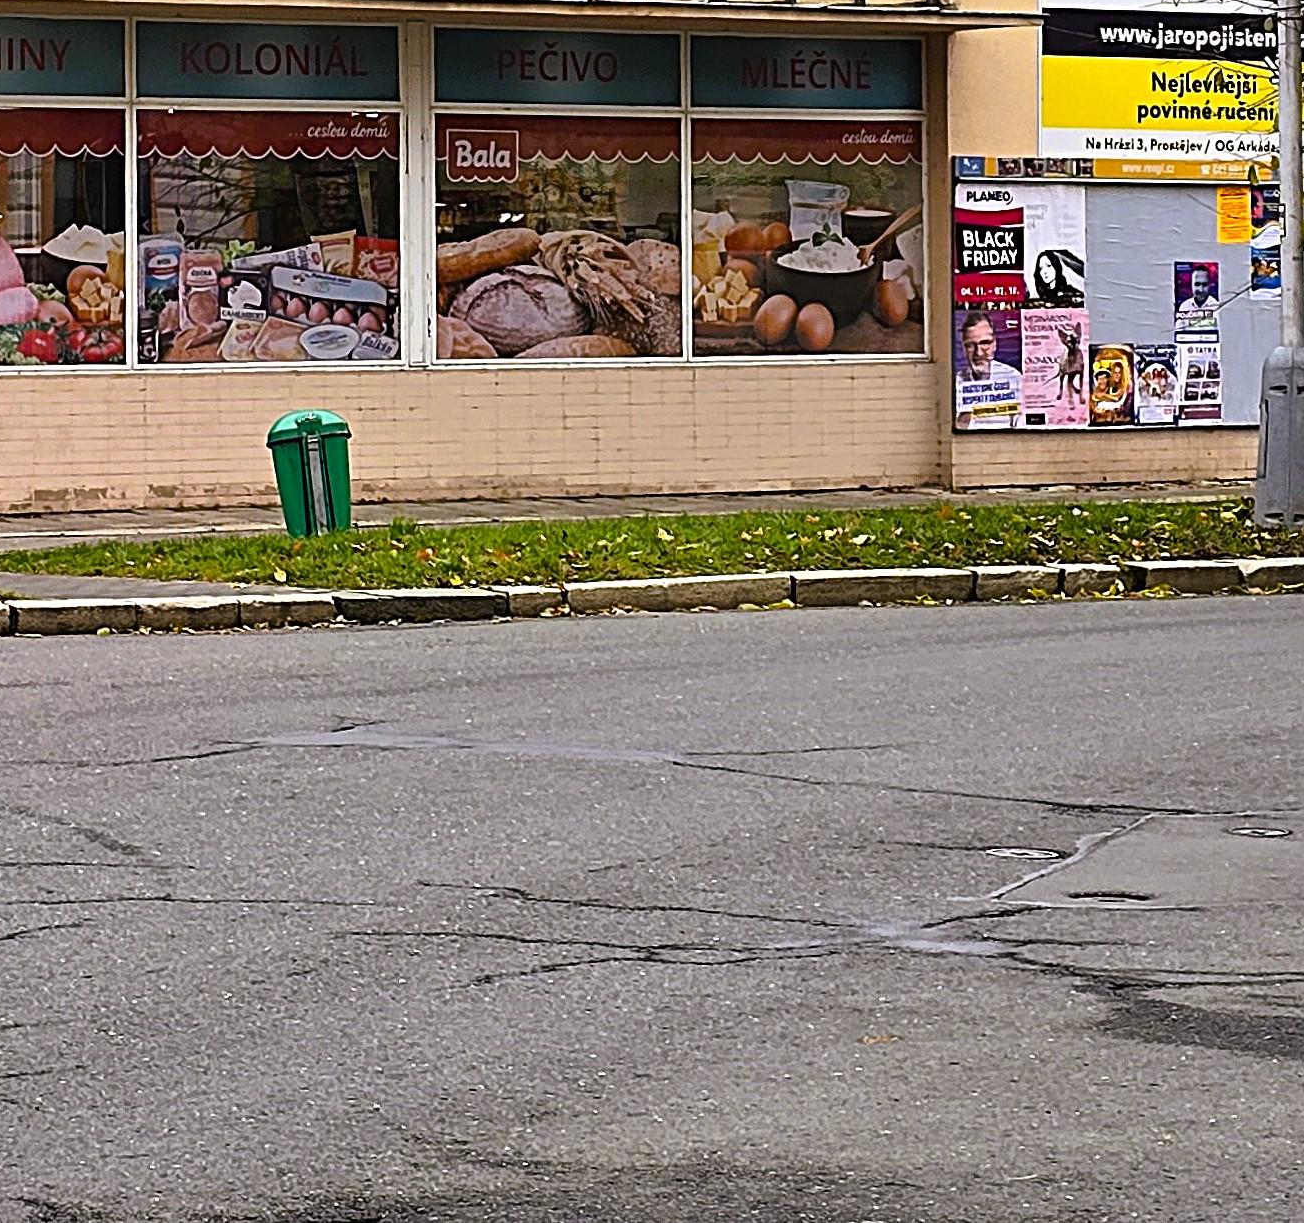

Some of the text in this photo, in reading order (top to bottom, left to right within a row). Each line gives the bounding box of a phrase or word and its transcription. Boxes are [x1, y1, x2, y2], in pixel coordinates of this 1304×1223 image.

[180, 36, 369, 77] KOLONIÁL
[497, 41, 618, 83] PEČIVO
[740, 49, 872, 91] MLÉČNÉ
[1137, 101, 1213, 124] povinné
[307, 119, 349, 138] cestou
[350, 116, 391, 138] domů
[841, 128, 878, 145] cestou
[880, 128, 914, 145] domů
[455, 139, 512, 170] Bala
[1086, 138, 1101, 150] Na
[1137, 139, 1148, 153] 3,
[1214, 140, 1235, 152] OG
[966, 191, 1013, 204] PLANEO
[962, 230, 1015, 248] BLACK
[963, 249, 1018, 268] FRIDAY
